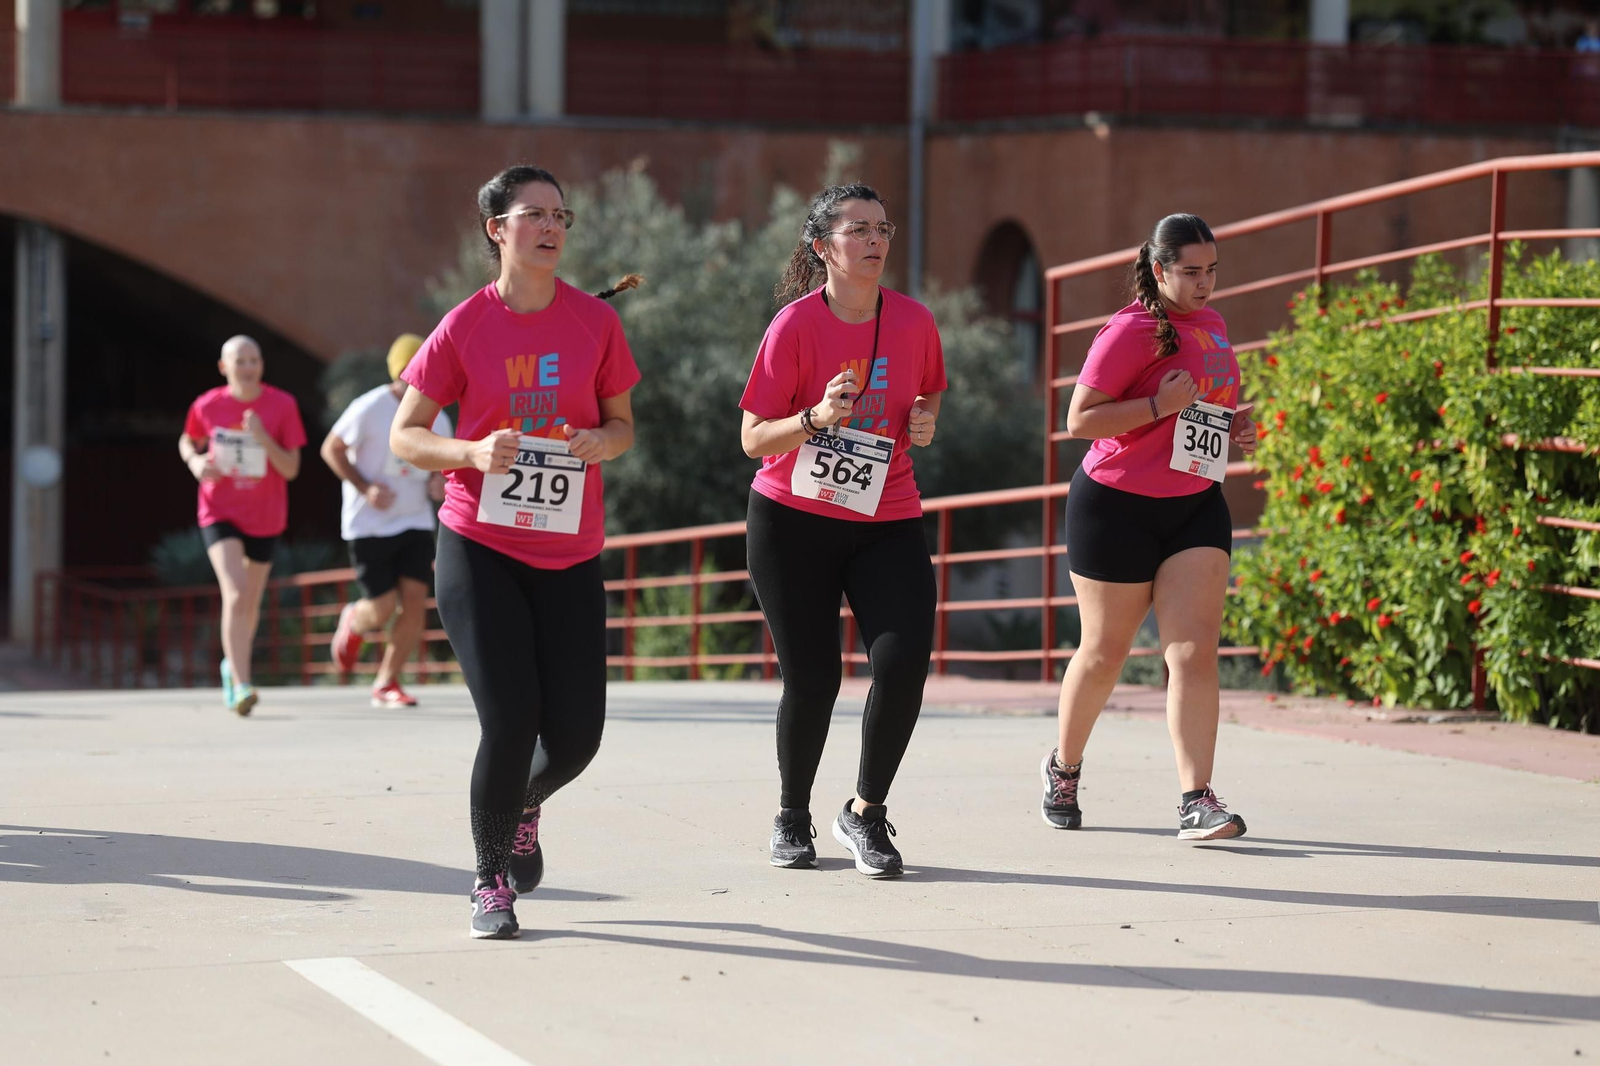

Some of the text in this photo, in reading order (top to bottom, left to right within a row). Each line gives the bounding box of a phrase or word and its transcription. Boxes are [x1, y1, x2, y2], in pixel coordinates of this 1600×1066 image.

[1190, 328, 1230, 350] WE
[505, 352, 560, 388] WE
[840, 357, 888, 390] WE
[513, 391, 555, 415] RUN
[1183, 408, 1205, 424] UMA
[1184, 425, 1222, 459] 340
[513, 451, 539, 465] MA
[810, 451, 874, 490] 564
[501, 468, 570, 506] 219
[820, 490, 835, 498] WE
[516, 513, 533, 524] WE
